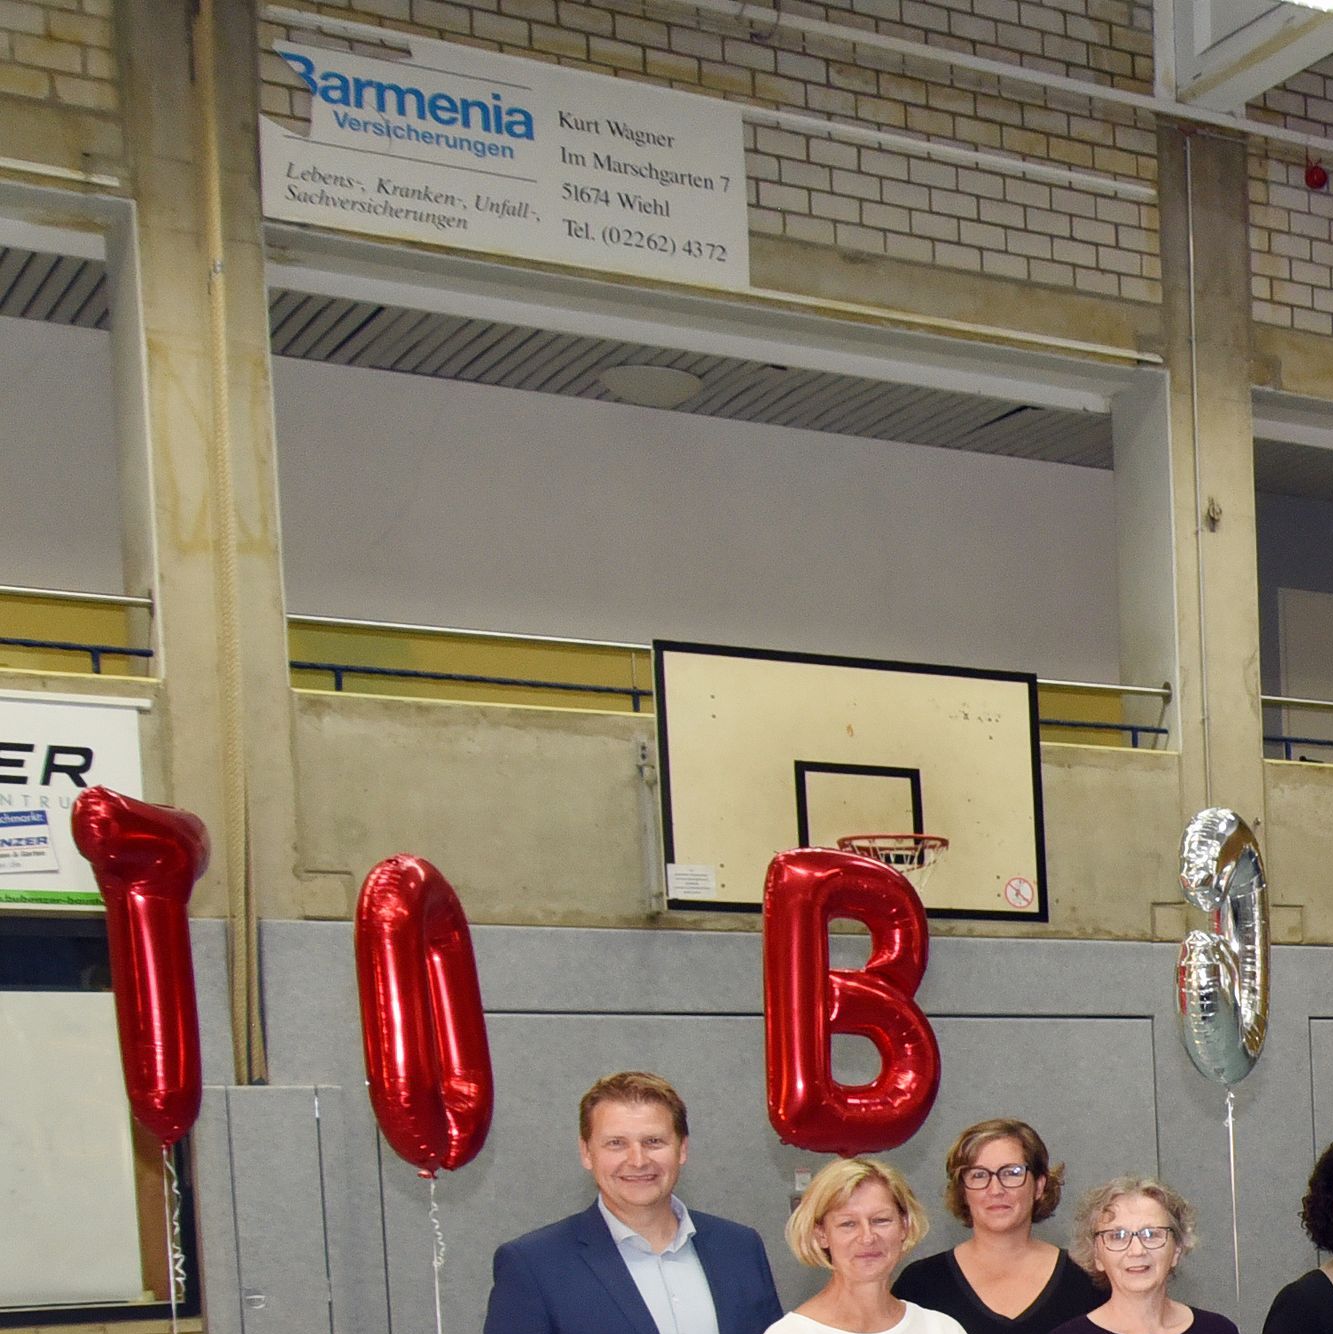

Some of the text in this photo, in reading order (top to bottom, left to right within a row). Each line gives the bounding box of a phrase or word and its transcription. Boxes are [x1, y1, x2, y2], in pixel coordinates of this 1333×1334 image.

[333, 110, 514, 159] Versicherungen
[558, 110, 675, 148] Kurt Wagner
[286, 162, 366, 192] Lebens-,
[376, 177, 467, 210] Kranken-,
[560, 146, 730, 192] Im Marschgarten 7
[285, 184, 468, 230] Sachversicherungen
[562, 182, 670, 218] 51674 Wiehl
[562, 218, 595, 241] Tel.
[602, 225, 676, 257] (02262)
